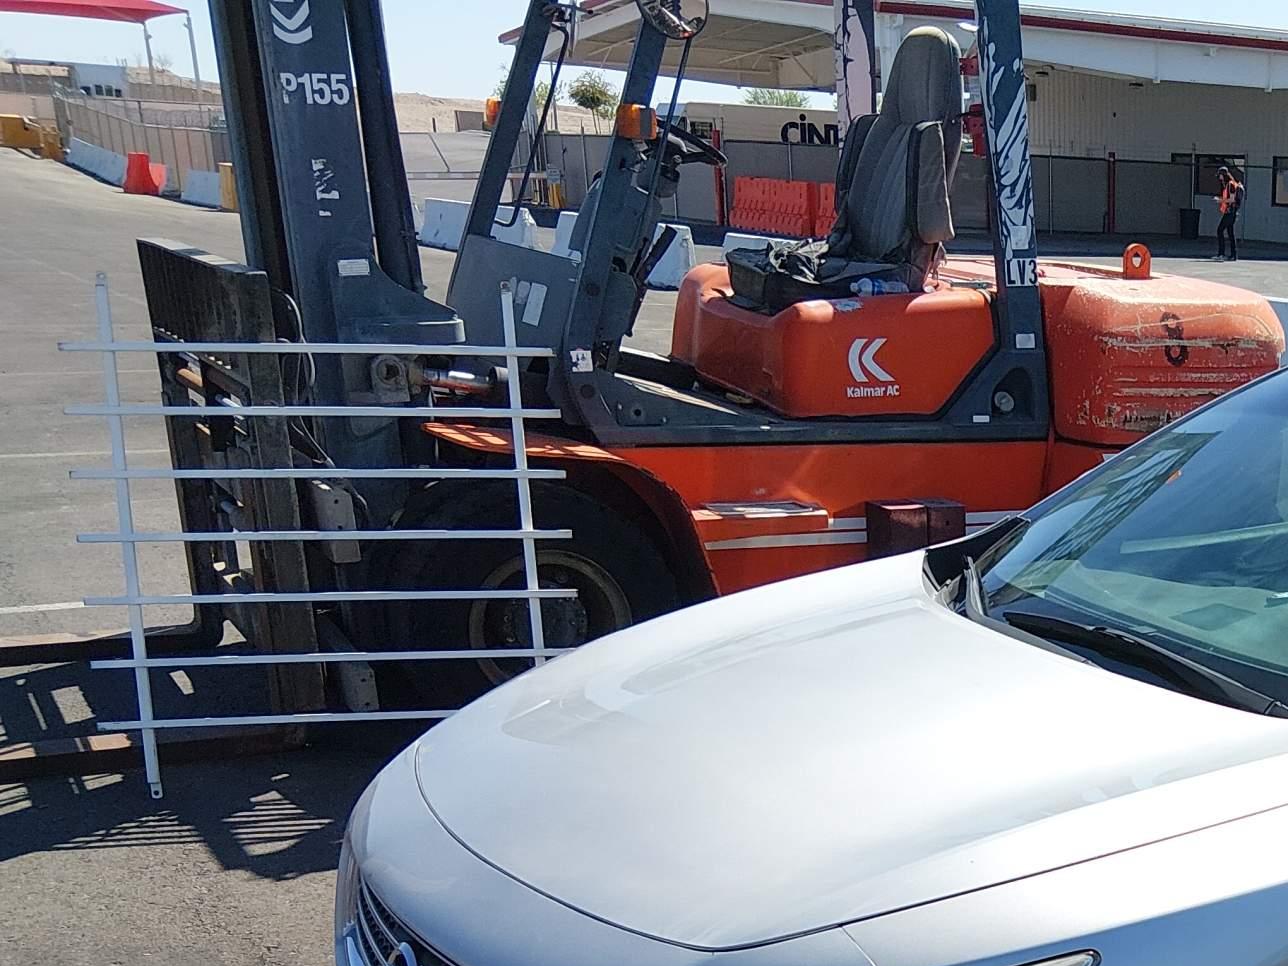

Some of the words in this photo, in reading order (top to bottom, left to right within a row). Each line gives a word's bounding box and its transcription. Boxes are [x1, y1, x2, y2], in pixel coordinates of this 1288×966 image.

[279, 72, 350, 105] P155
[1006, 259, 1038, 286] LV3
[847, 386, 885, 398] Kalmar
[886, 384, 900, 397] AC
